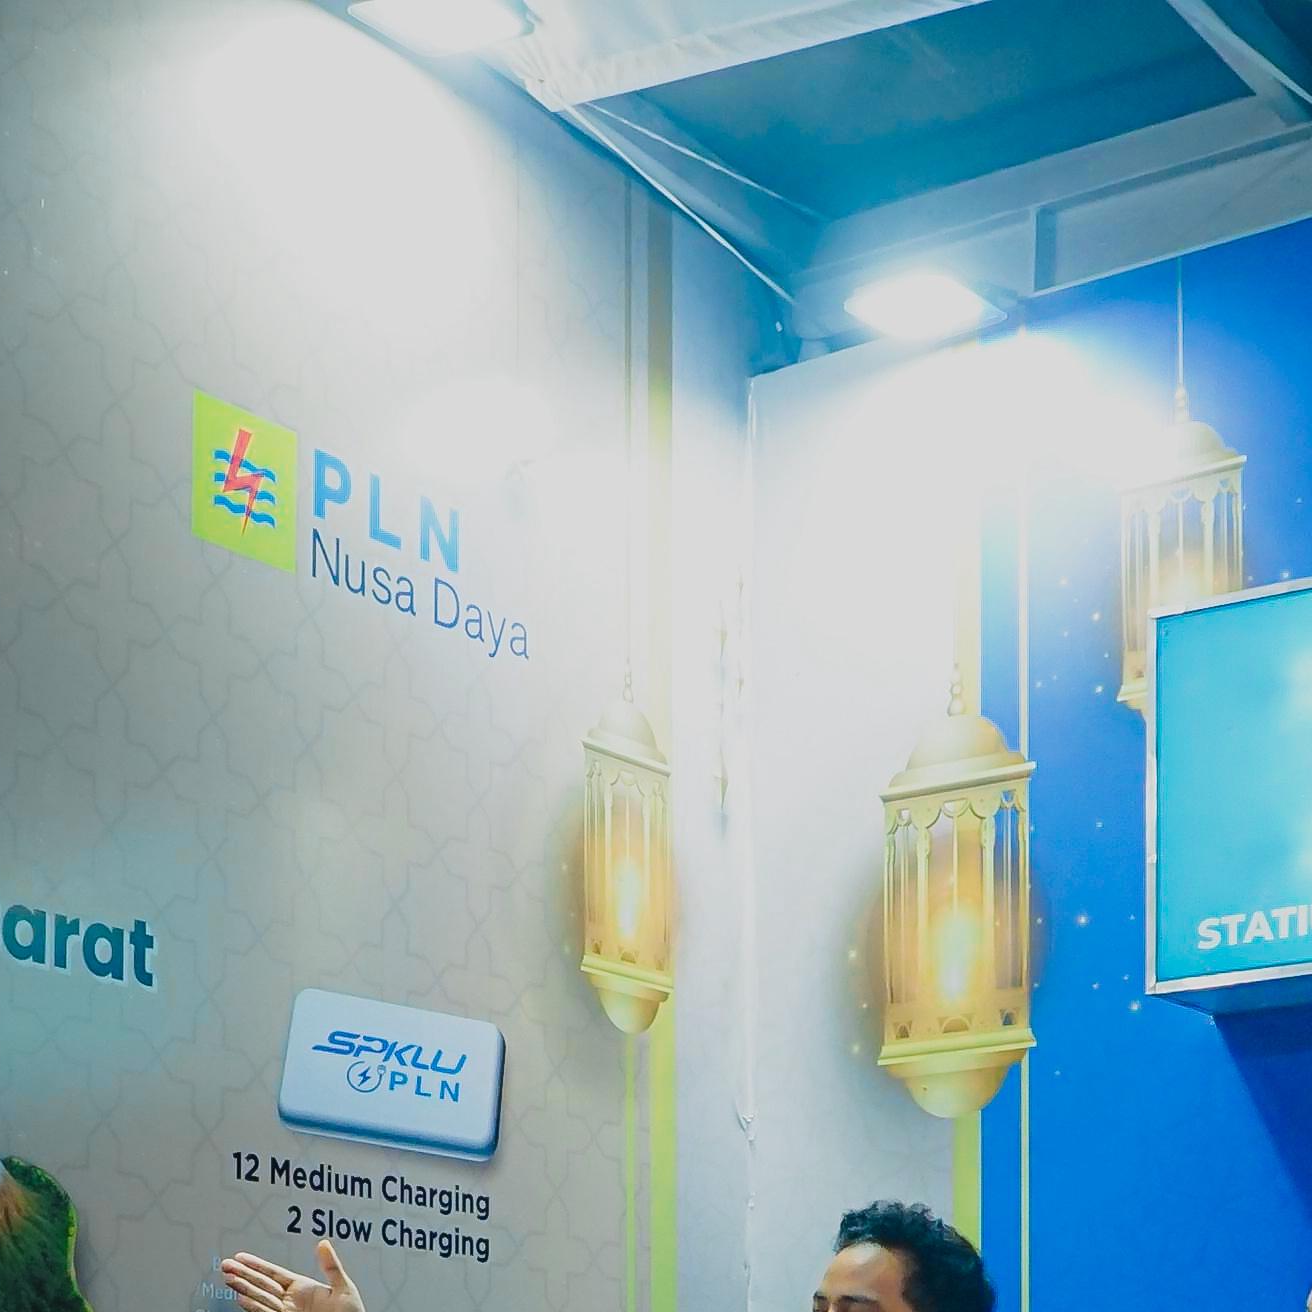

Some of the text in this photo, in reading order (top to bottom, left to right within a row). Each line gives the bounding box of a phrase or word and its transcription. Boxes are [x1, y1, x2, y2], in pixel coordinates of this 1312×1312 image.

[312, 448, 460, 574] PLN
[311, 528, 529, 660] Nusa Daya
[312, 1030, 467, 1076] SPKLU
[388, 1070, 461, 1103] PLN
[232, 1152, 490, 1220] 12 Medium Charging
[287, 1206, 490, 1263] 2 Slow Charging
